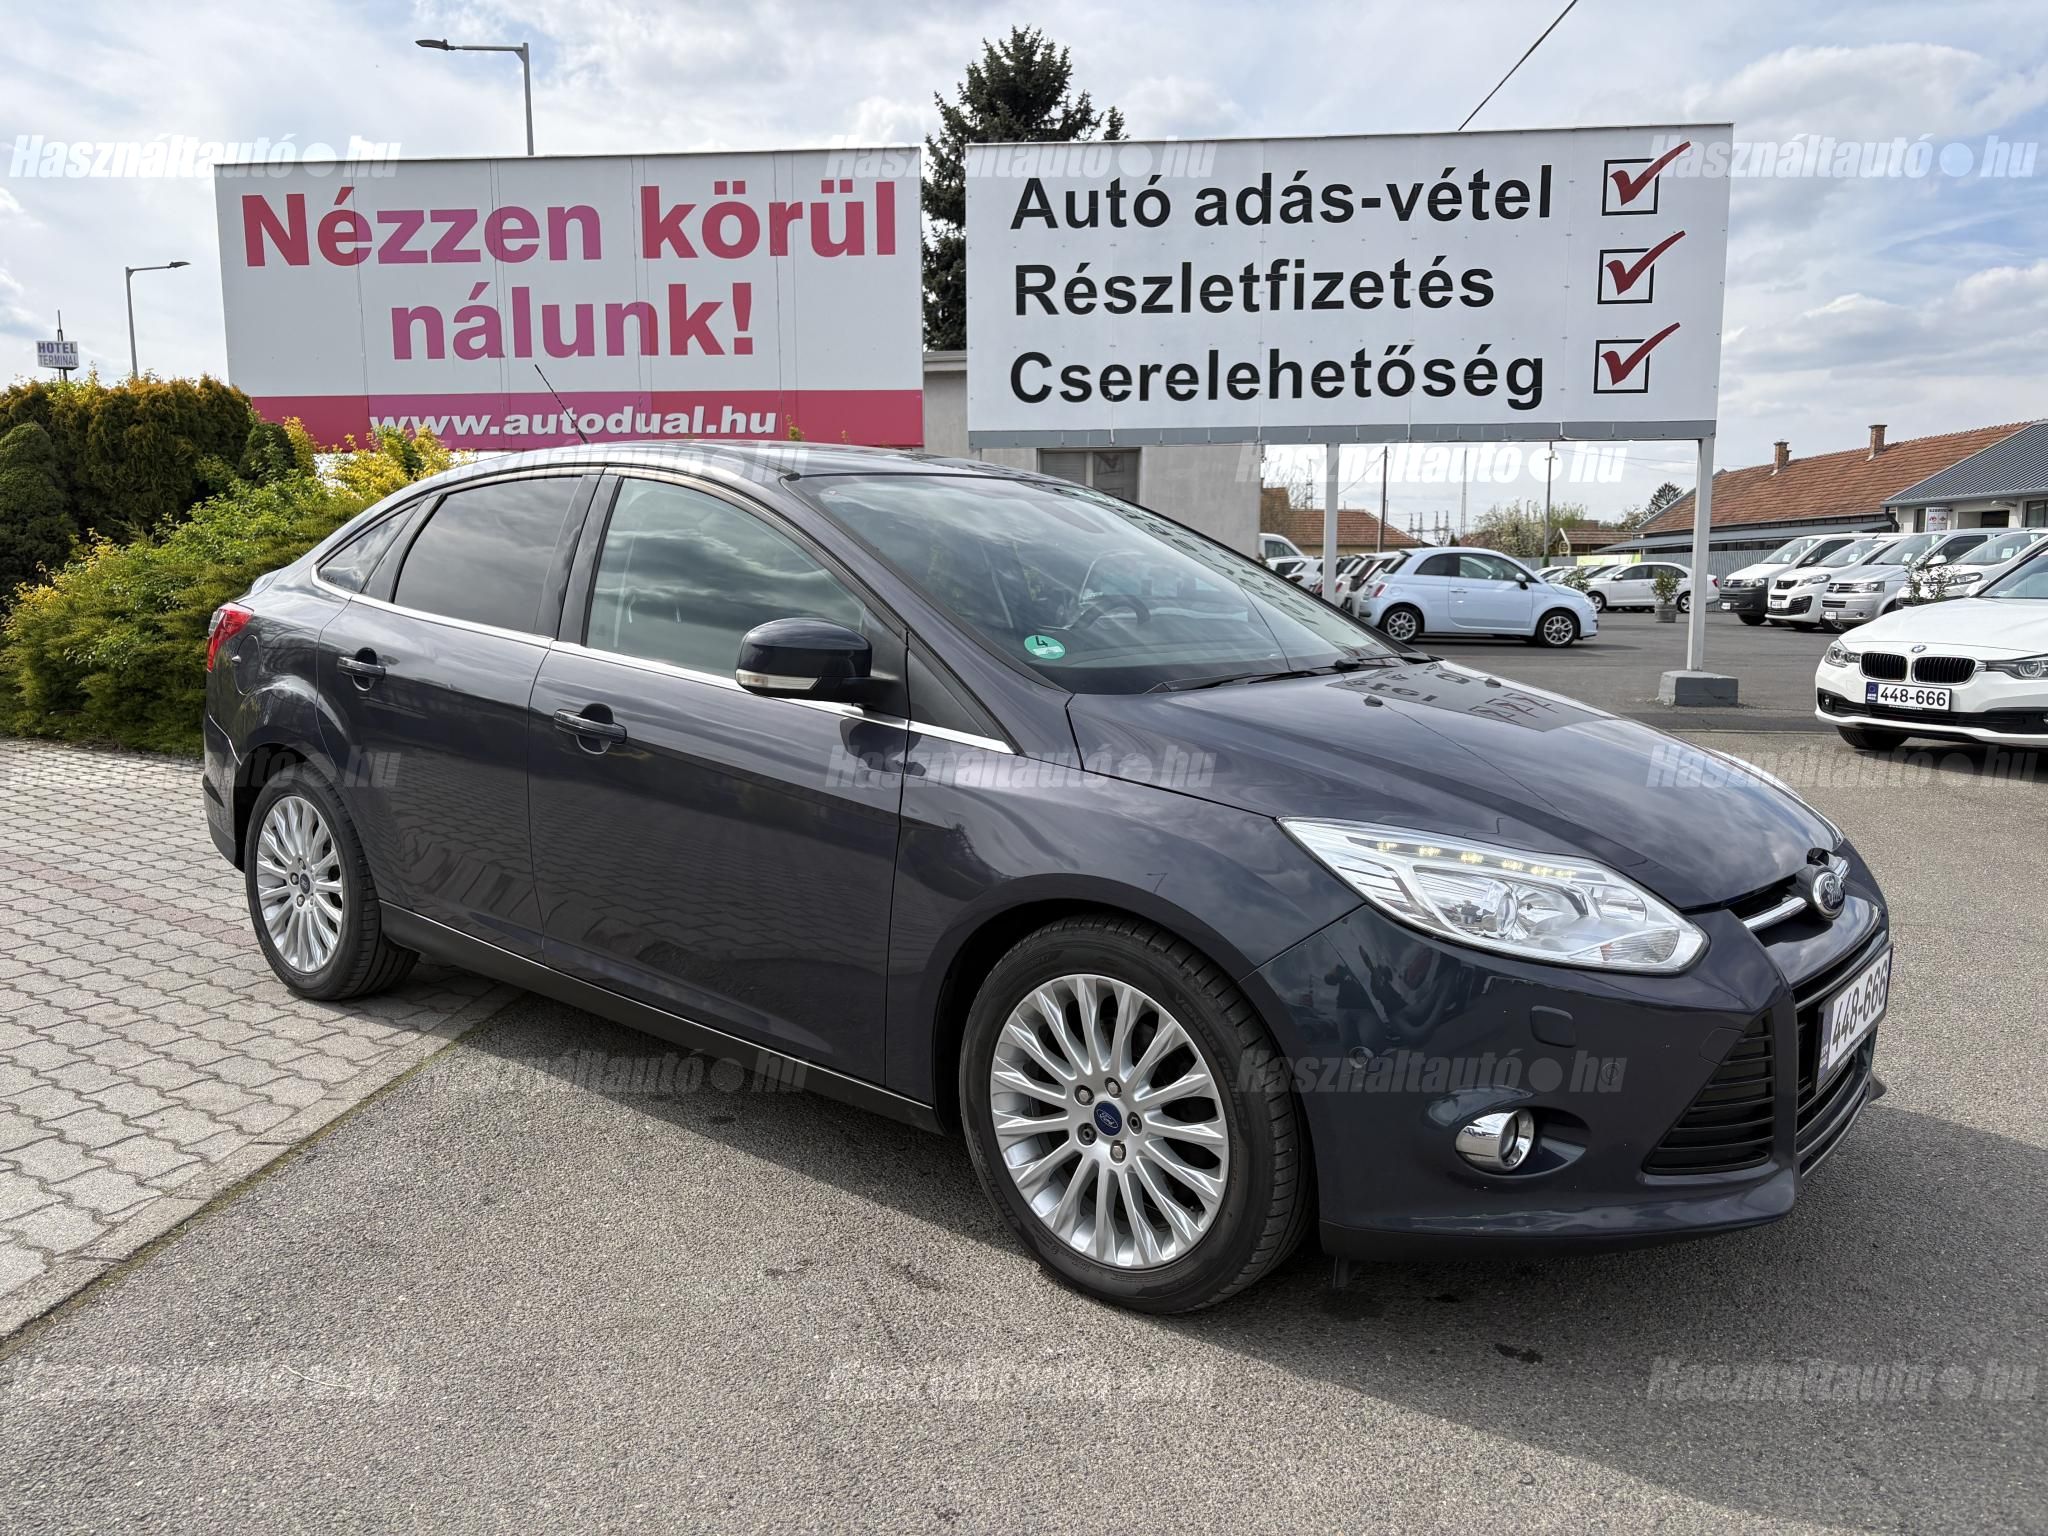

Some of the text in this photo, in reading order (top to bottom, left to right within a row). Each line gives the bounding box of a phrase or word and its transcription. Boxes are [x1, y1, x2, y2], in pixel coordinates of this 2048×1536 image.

[241, 179, 896, 267] Nézzen körül
[1010, 165, 1552, 230] Autó adás-vétel
[1015, 255, 1495, 316] Részletfizetés
[37, 342, 77, 354] HOTEL
[391, 281, 753, 360] nálunk!
[38, 354, 78, 366] TERMINAL
[1010, 343, 1543, 411] Cserelehetőség
[369, 405, 777, 437] www.autodual.hu
[1880, 687, 1947, 707] 448-666
[1831, 959, 1888, 1051] 448-666
